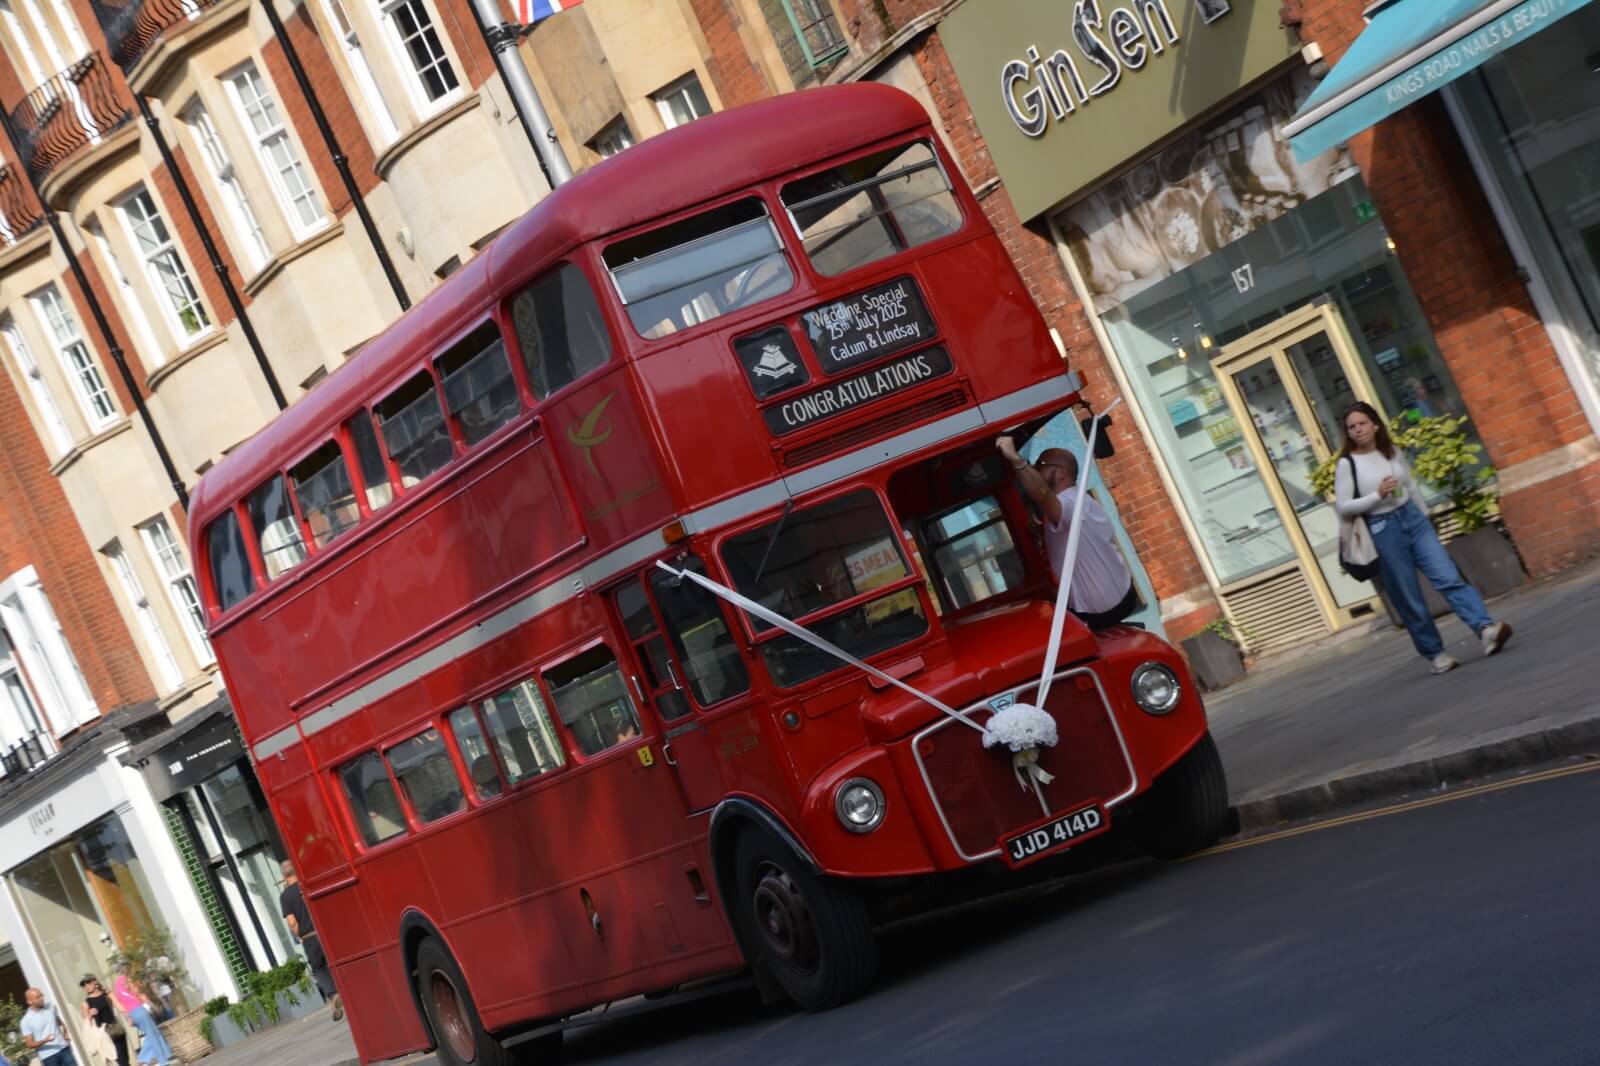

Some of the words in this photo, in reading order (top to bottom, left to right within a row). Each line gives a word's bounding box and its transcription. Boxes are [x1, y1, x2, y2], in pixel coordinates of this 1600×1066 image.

[1385, 71, 1424, 104] KINGS
[1424, 50, 1462, 83] ROAD
[1462, 26, 1501, 58] NAILS
[1501, 19, 1513, 38] &
[1232, 263, 1255, 294] 157
[811, 302, 861, 327] Wedding
[862, 284, 908, 310] Special
[826, 320, 851, 341] 25th
[855, 311, 880, 332] July
[878, 300, 908, 322] 2025
[830, 342, 867, 361] Calum
[867, 333, 877, 350] &
[876, 321, 920, 346] Lindsay
[782, 356, 932, 426] CONGRATULATIONS
[1013, 830, 1050, 859] JJD
[1054, 809, 1100, 840] 414D
